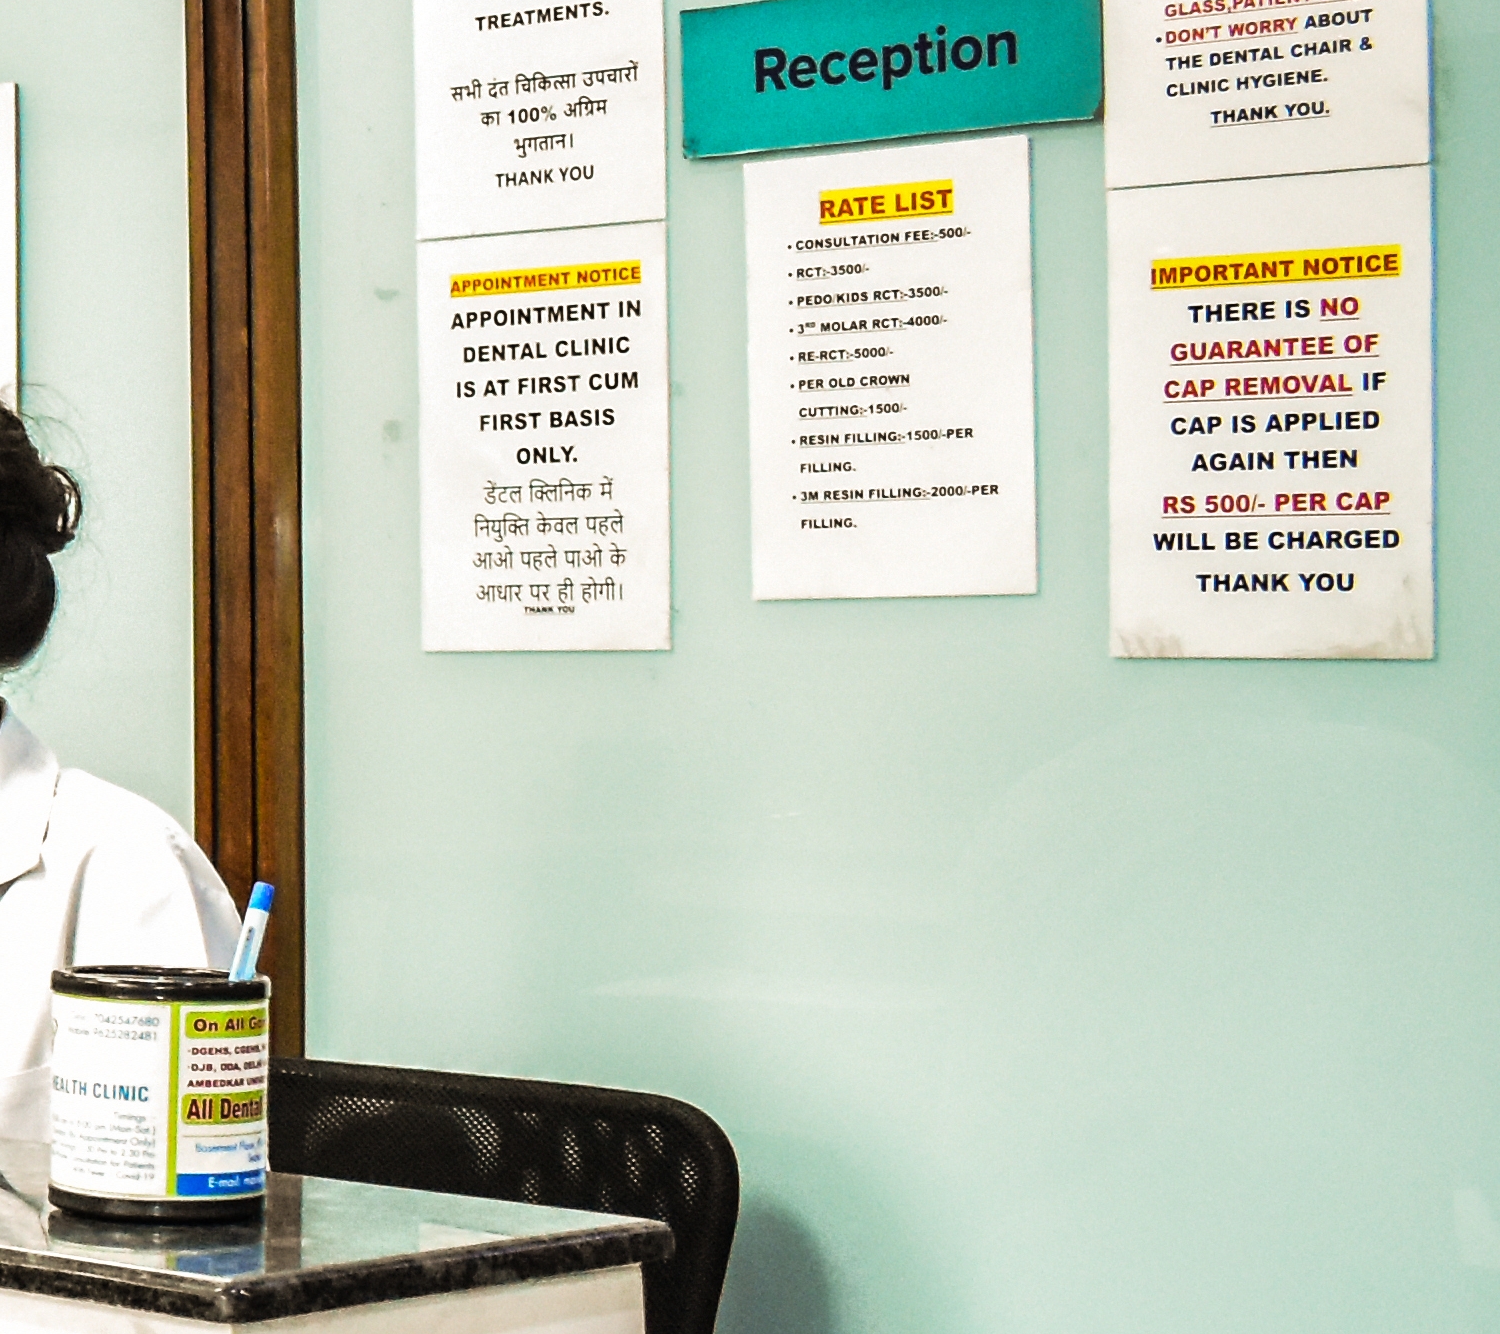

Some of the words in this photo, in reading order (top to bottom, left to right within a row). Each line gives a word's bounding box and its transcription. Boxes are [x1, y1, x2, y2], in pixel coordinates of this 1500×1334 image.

[476, 1, 608, 30] TREATMENTS.
[755, 24, 1018, 93] Reception
[820, 195, 885, 218] RATE
[896, 189, 952, 213] LIST
[796, 233, 899, 251] CONSULTATION
[451, 272, 570, 293] APPOINTMENT
[577, 266, 640, 284] NOTICE
[1151, 260, 1294, 285] IMPORTANT
[1304, 253, 1398, 280] NOTICE
[452, 302, 609, 329] APPOINTMENT
[619, 300, 641, 318] IN
[1188, 301, 1275, 323] THERE
[1286, 299, 1310, 319] IS
[1321, 296, 1358, 319] NO
[464, 343, 547, 363] DENTAL
[556, 336, 629, 358] CLINIC
[1171, 336, 1333, 361] GUARANTEE
[1344, 334, 1378, 354] OF
[457, 380, 475, 398] IS
[484, 378, 509, 397] AT
[519, 375, 580, 395] FIRST
[589, 371, 638, 391] CUM
[1165, 379, 1214, 398] CAP
[1226, 374, 1352, 397] REMOVAL
[1363, 371, 1386, 391] IF
[481, 412, 541, 431] FIRST
[550, 408, 614, 428] BASIS
[517, 446, 577, 465] ONLY.
[1164, 495, 1195, 514] RS
[1275, 493, 1326, 512] PER
[1337, 492, 1389, 511] CAP
[1196, 573, 1289, 592] THANK
[1299, 573, 1354, 591] YOU
[193, 1018, 219, 1033] On
[224, 1017, 245, 1032] All
[93, 1082, 149, 1102] CLINIC
[187, 1098, 213, 1120] All
[220, 1093, 262, 1120] Dental
